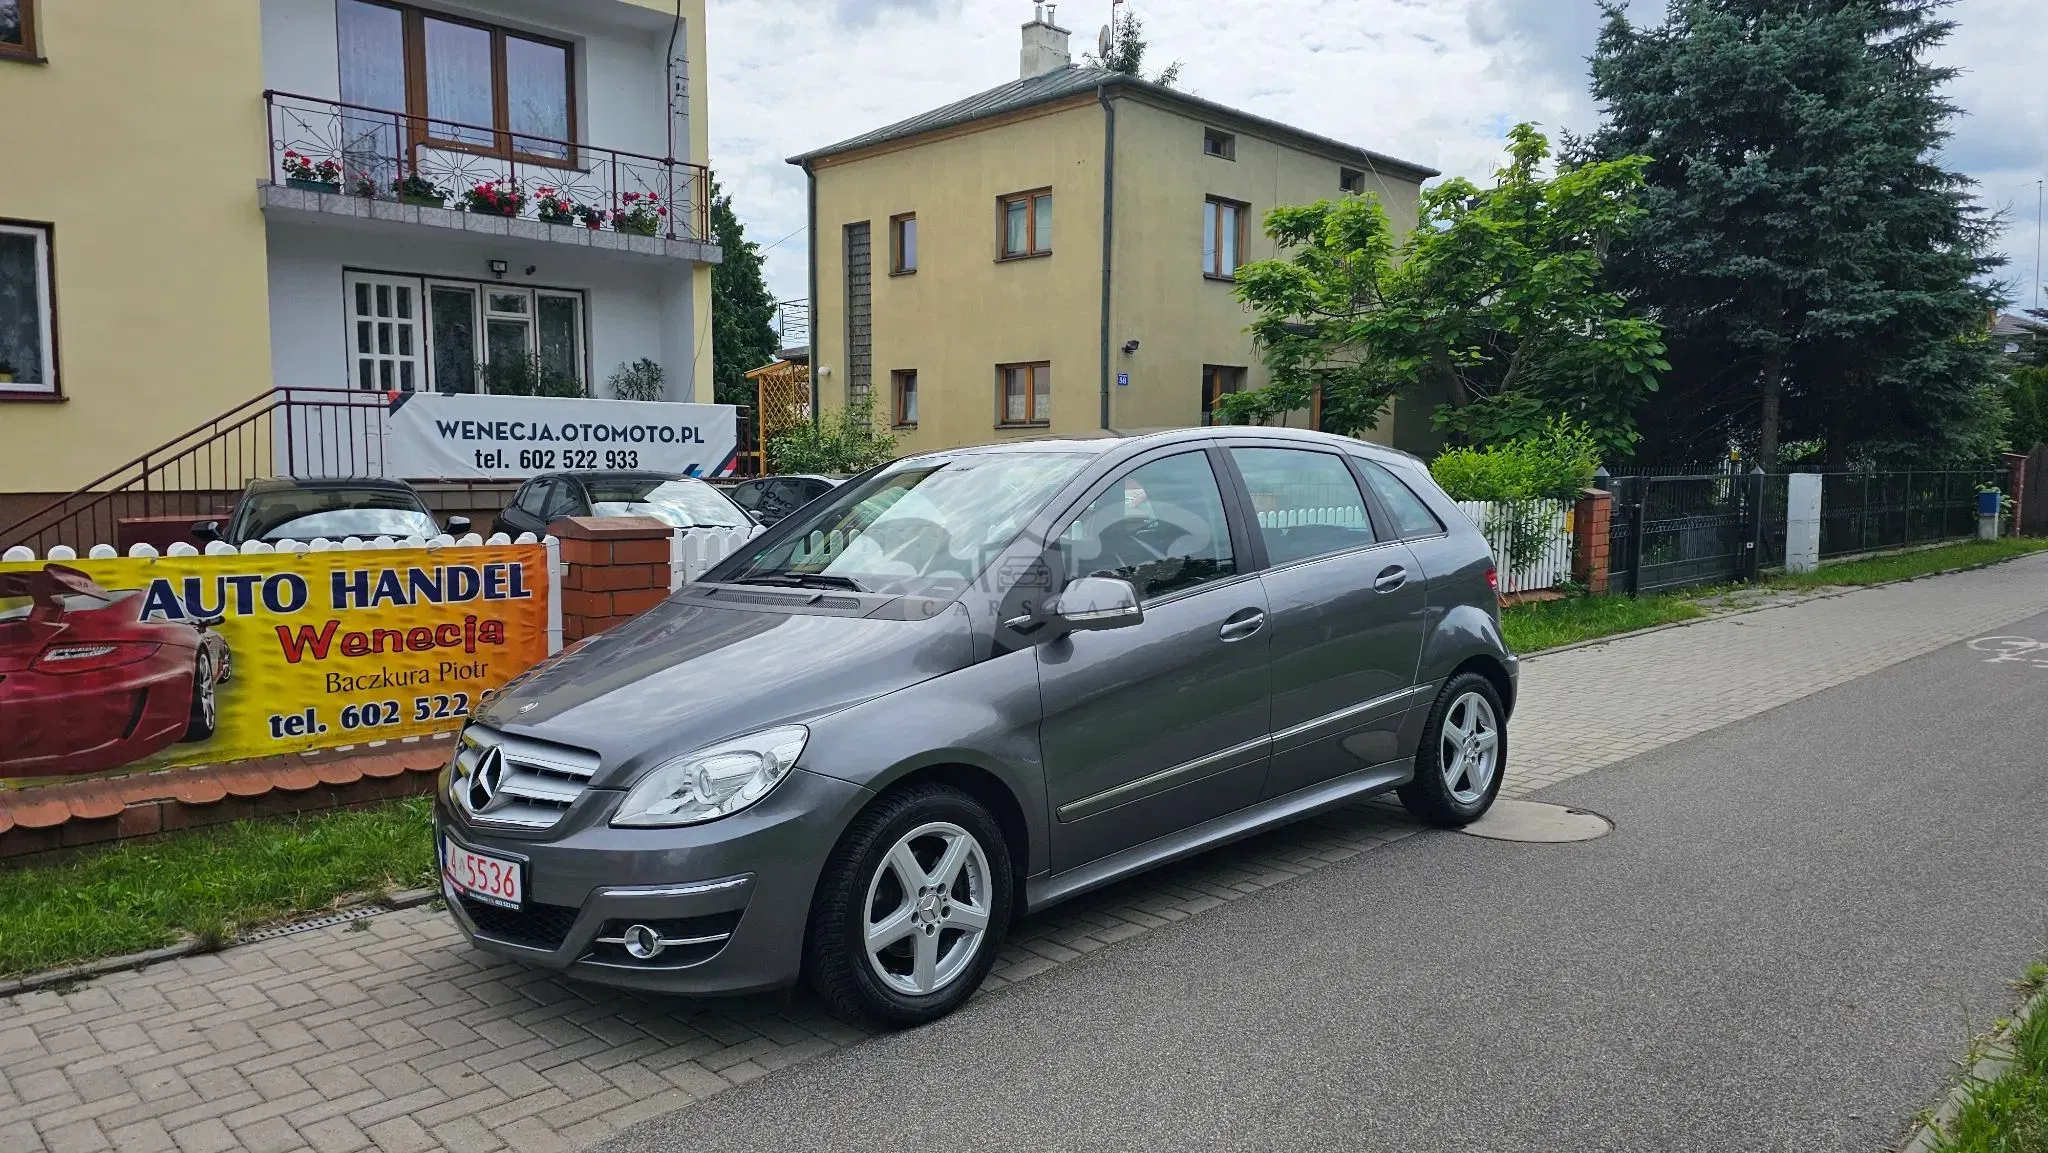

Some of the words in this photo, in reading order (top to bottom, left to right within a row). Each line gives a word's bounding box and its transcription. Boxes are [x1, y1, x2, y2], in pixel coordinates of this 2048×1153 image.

[436, 420, 705, 444] WENECJA.OTOMOTO.PL
[475, 449, 509, 469] tel.
[519, 450, 555, 469] 602
[563, 450, 597, 470] 522
[606, 450, 638, 469] 933
[138, 573, 309, 622] AUTO
[331, 563, 531, 609] HANDEL
[275, 614, 504, 663] Wenecja
[326, 666, 430, 693] Baczkura
[439, 660, 489, 681] Piotr
[268, 707, 328, 738] tel.
[340, 700, 401, 731] 602
[414, 692, 470, 722] 522
[467, 854, 515, 898] 5536
